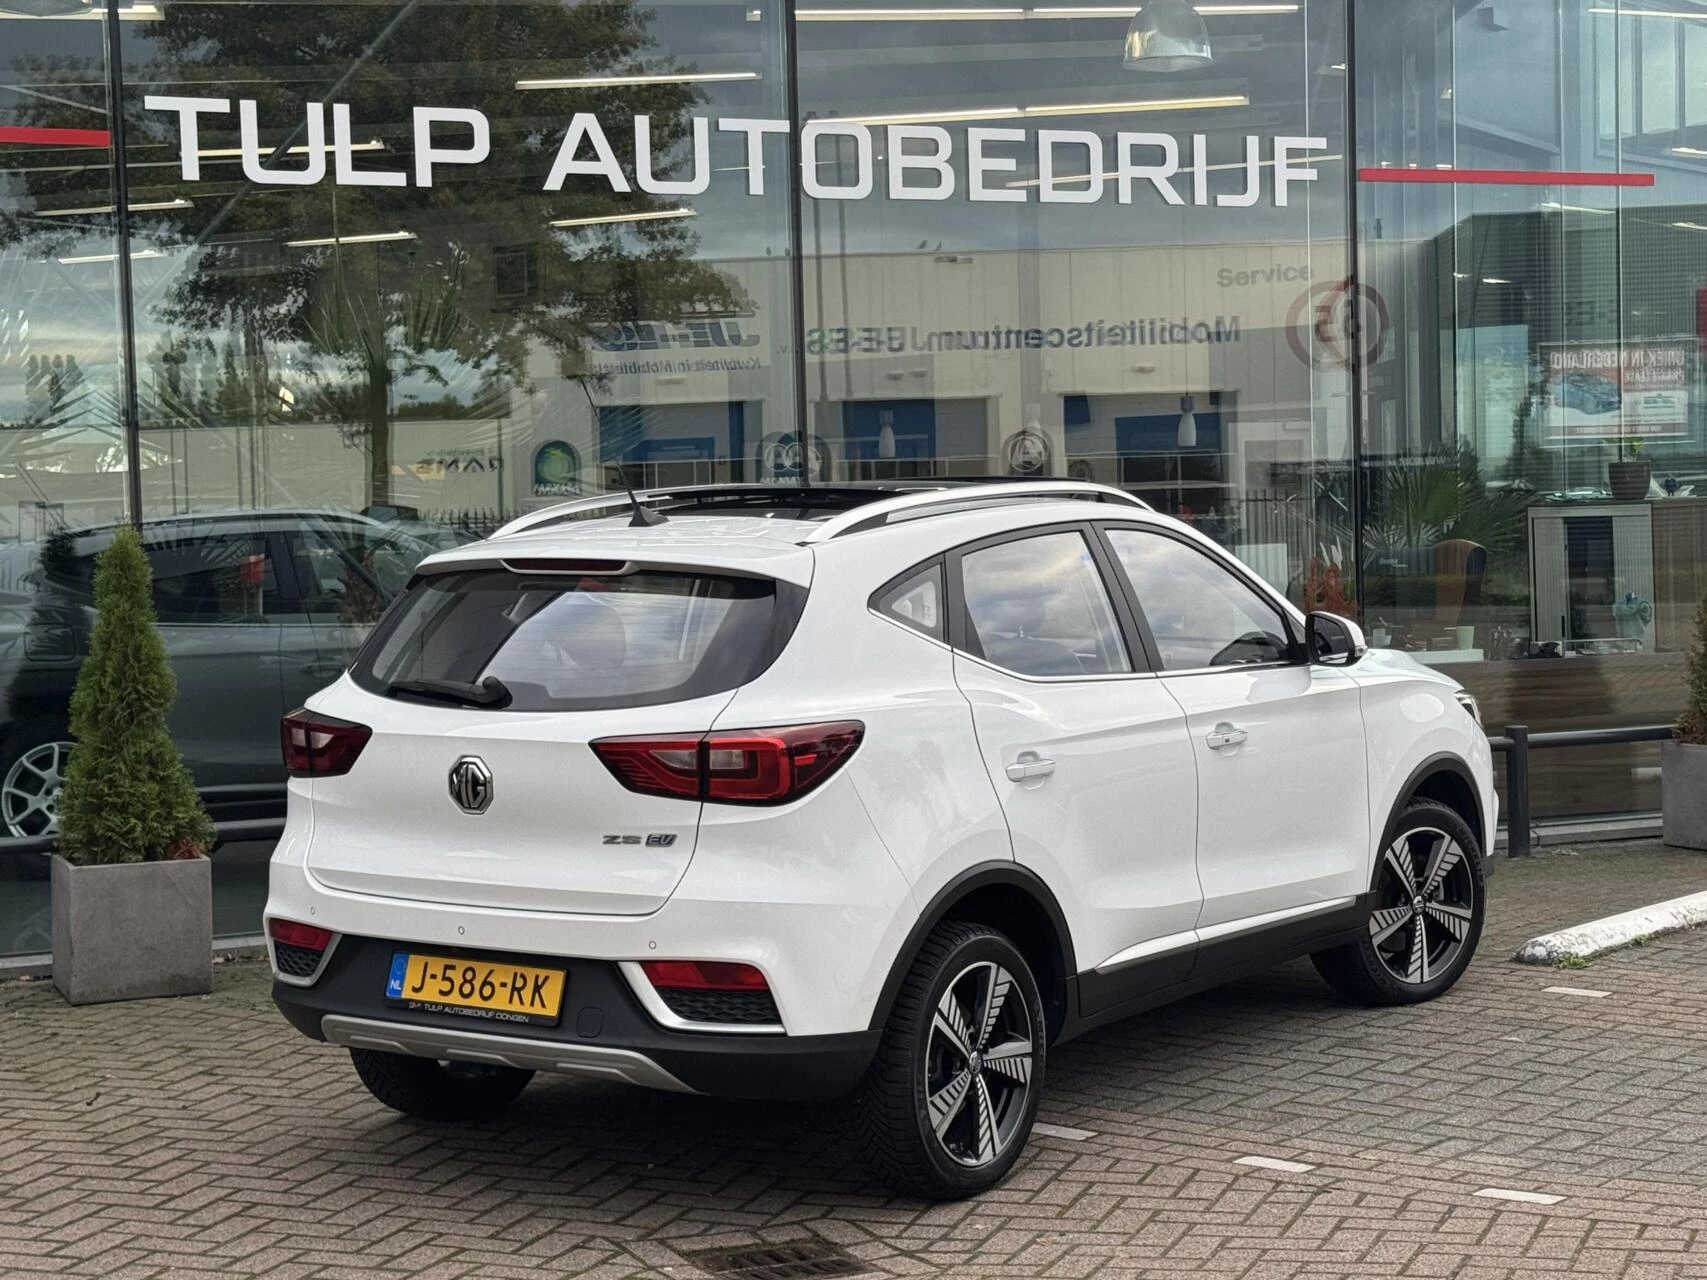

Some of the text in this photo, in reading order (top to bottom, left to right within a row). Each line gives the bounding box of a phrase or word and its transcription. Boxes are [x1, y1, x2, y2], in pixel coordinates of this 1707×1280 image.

[144, 95, 1328, 208] TULP AUTOBEDRIJF
[1217, 264, 1312, 288] Service
[450, 760, 488, 811] MG
[602, 834, 677, 847] ZS EV
[389, 978, 402, 991] NL
[410, 960, 551, 1010] J-586-RK
[424, 1002, 443, 1013] TULP
[443, 1006, 495, 1019] AUTOBEDRIJF
[496, 1011, 530, 1024] DONGEN
